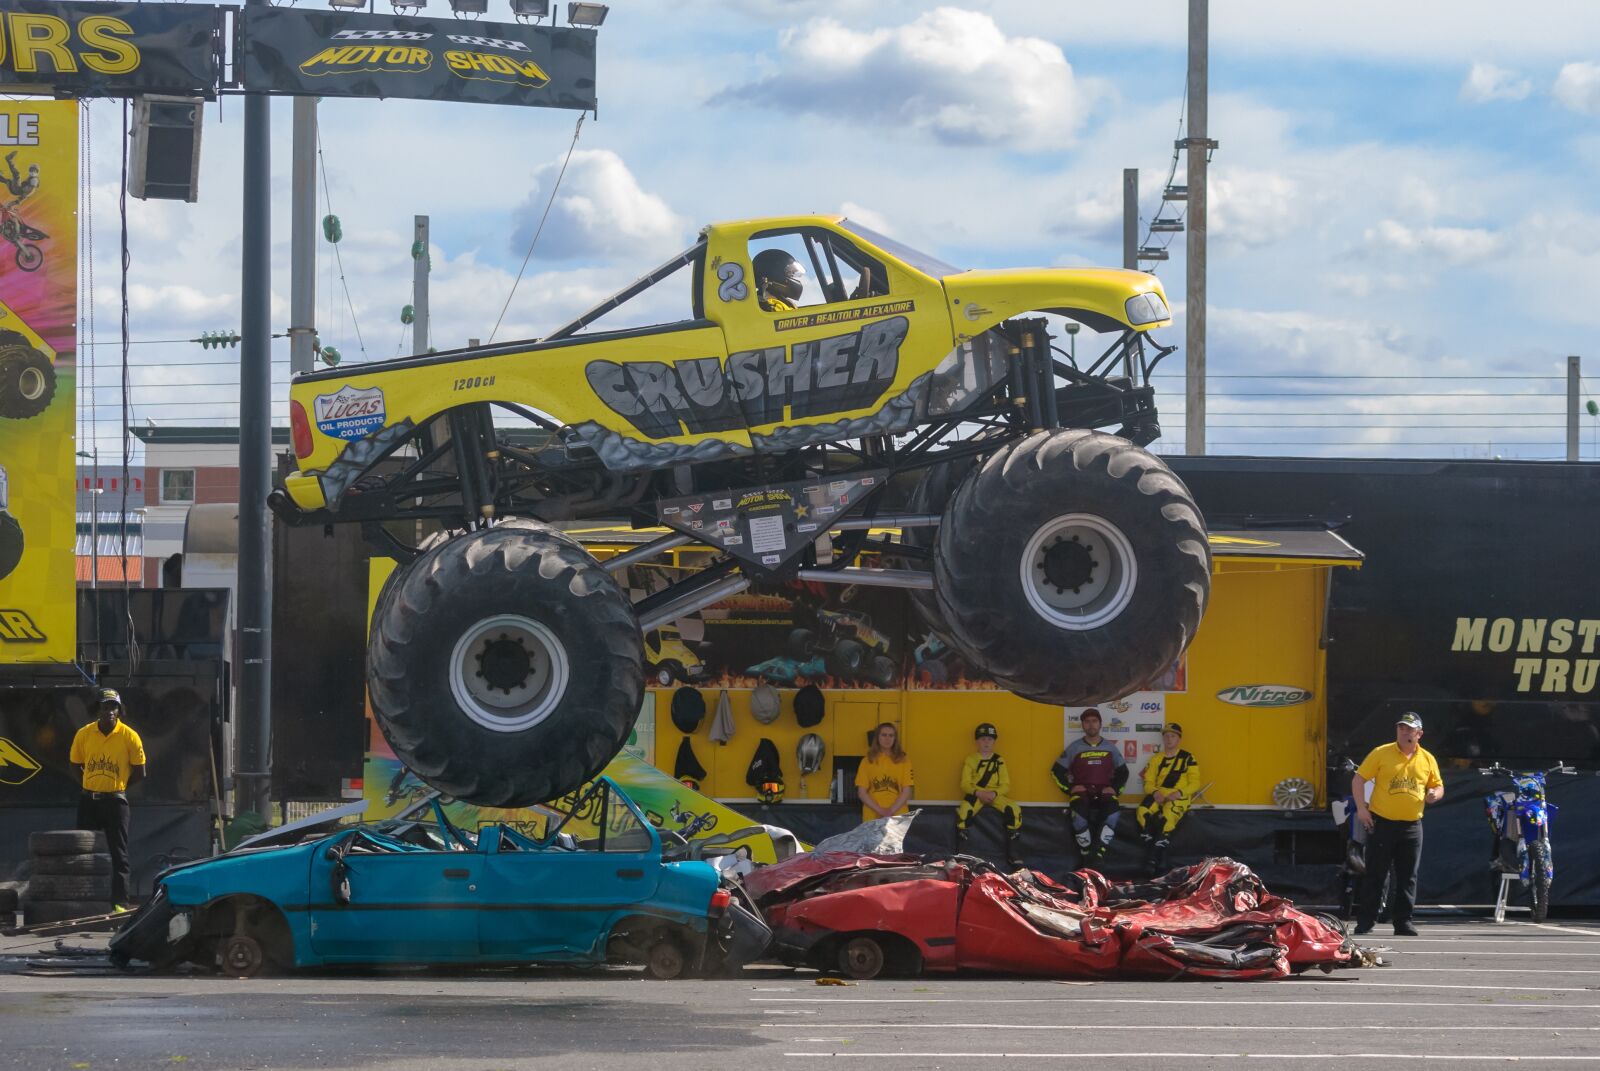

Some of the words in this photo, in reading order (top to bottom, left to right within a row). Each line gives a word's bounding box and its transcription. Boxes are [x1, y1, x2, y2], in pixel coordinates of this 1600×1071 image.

[0, 12, 141, 75] RS
[301, 46, 432, 71] MOTOR
[444, 50, 550, 83] SHOW
[777, 314, 808, 330] DRIVER
[816, 307, 860, 324] BEAUTOUR
[862, 301, 912, 317] ALEXANDRE
[585, 316, 909, 426] CRUSHER
[323, 398, 380, 420] LUCAS
[320, 423, 335, 431] OIL
[337, 416, 384, 429] PRODUCTS
[338, 427, 369, 438] .CO.UK
[736, 494, 764, 508] MOTOR
[1229, 686, 1304, 701] Nitro
[1140, 702, 1161, 711] IGOL
